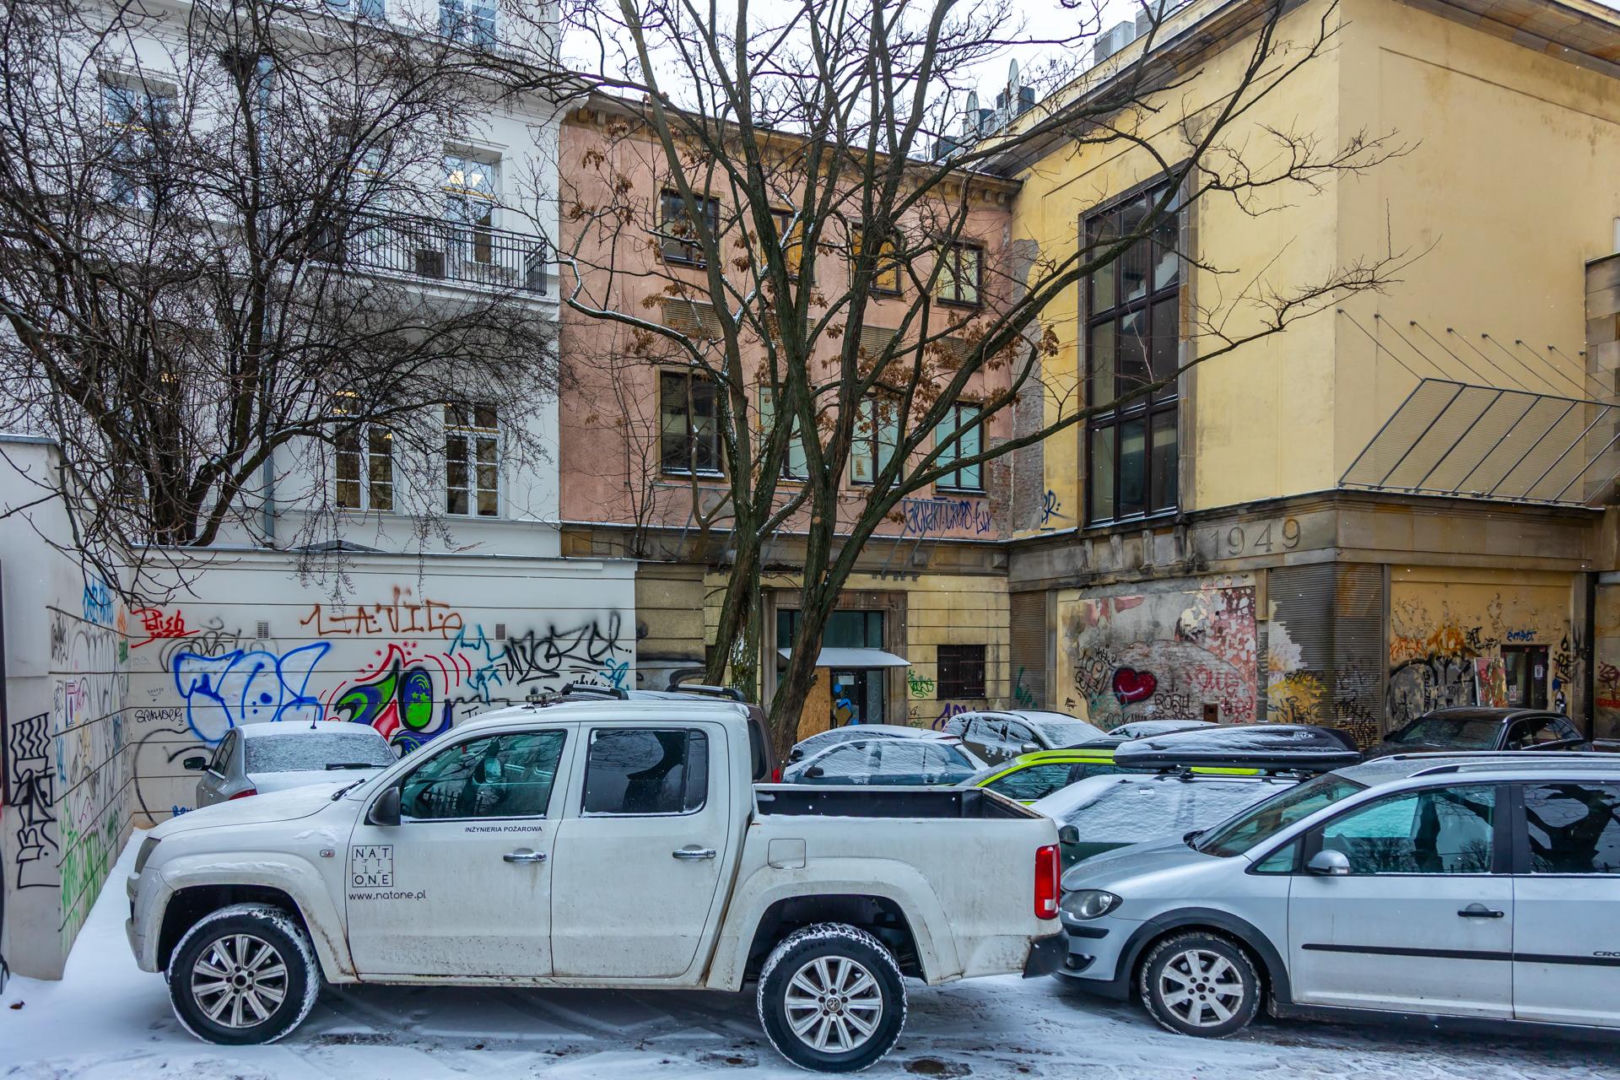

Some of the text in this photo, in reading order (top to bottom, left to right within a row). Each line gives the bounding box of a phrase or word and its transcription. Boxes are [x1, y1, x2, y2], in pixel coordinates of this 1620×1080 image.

[1210, 518, 1301, 559] 1949
[464, 825, 543, 833] INŻYNIERIA POŻAROWA
[355, 847, 390, 859] NAT
[354, 874, 390, 885] ONE
[348, 889, 427, 901] www.natone.pl
